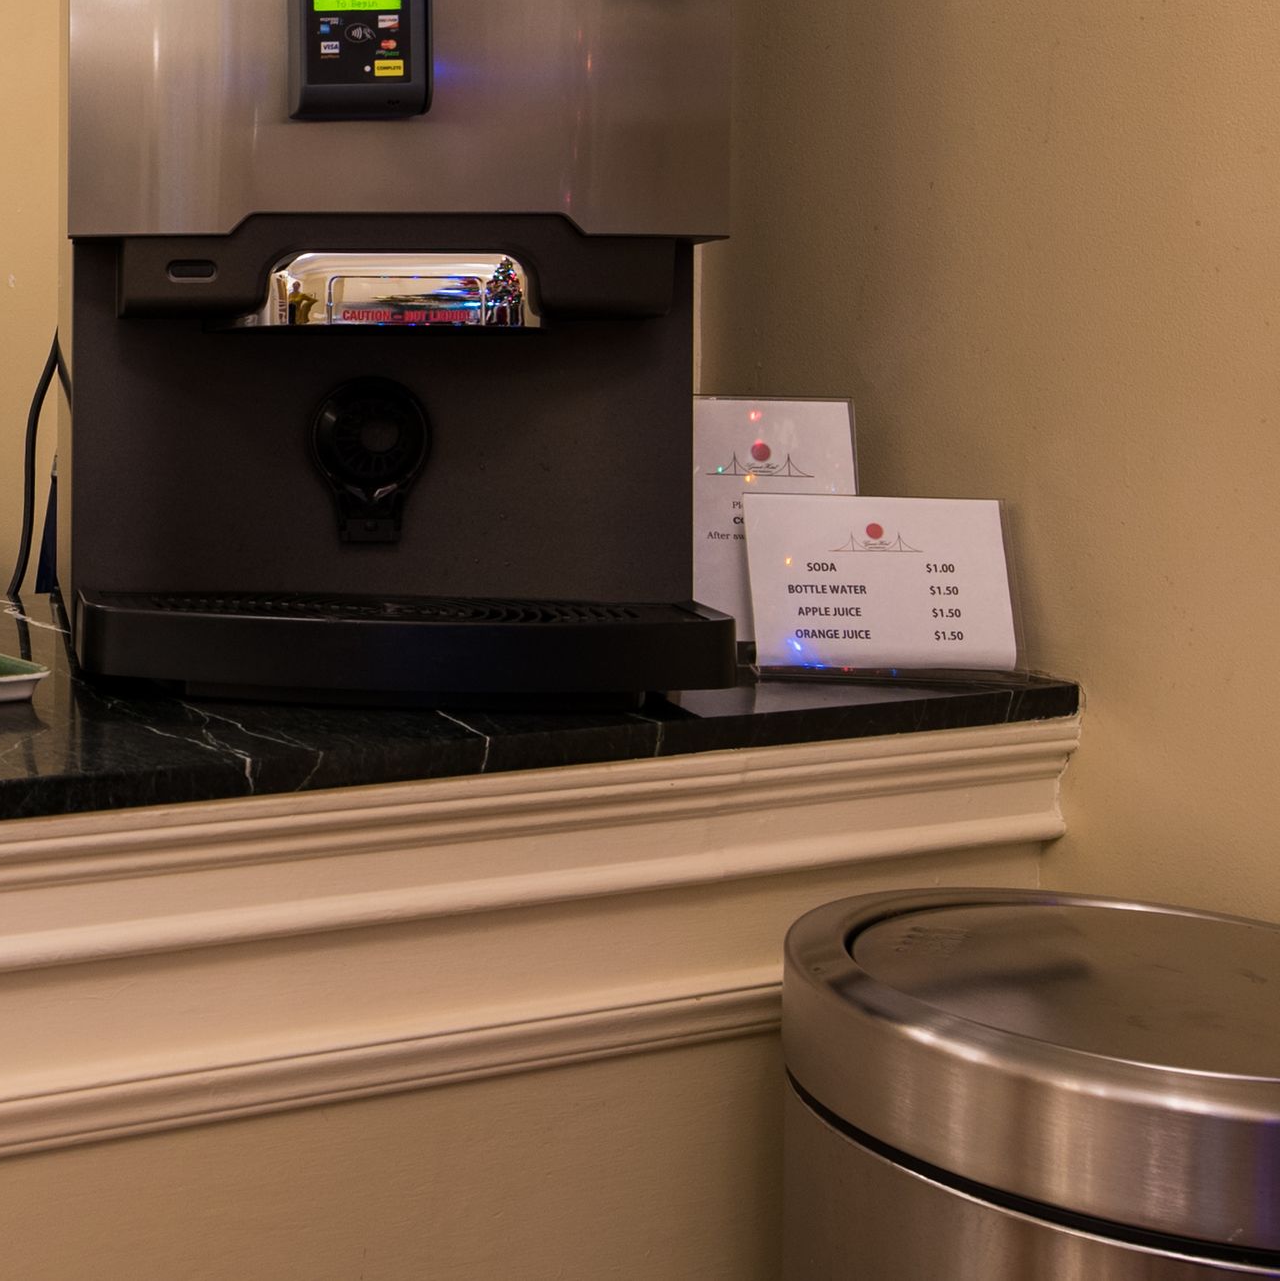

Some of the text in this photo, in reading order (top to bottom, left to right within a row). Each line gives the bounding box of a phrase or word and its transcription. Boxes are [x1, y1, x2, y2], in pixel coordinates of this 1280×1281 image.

[336, 0, 347, 8] To
[342, 309, 391, 321] CAUTION
[707, 530, 731, 540] After
[806, 562, 956, 574] SODA $1.00
[788, 584, 959, 596] BOTTLE WATER $1.50
[798, 606, 962, 618] APPLE JUICE $1.50
[795, 629, 964, 641] ORANGE JUICE $1.50
